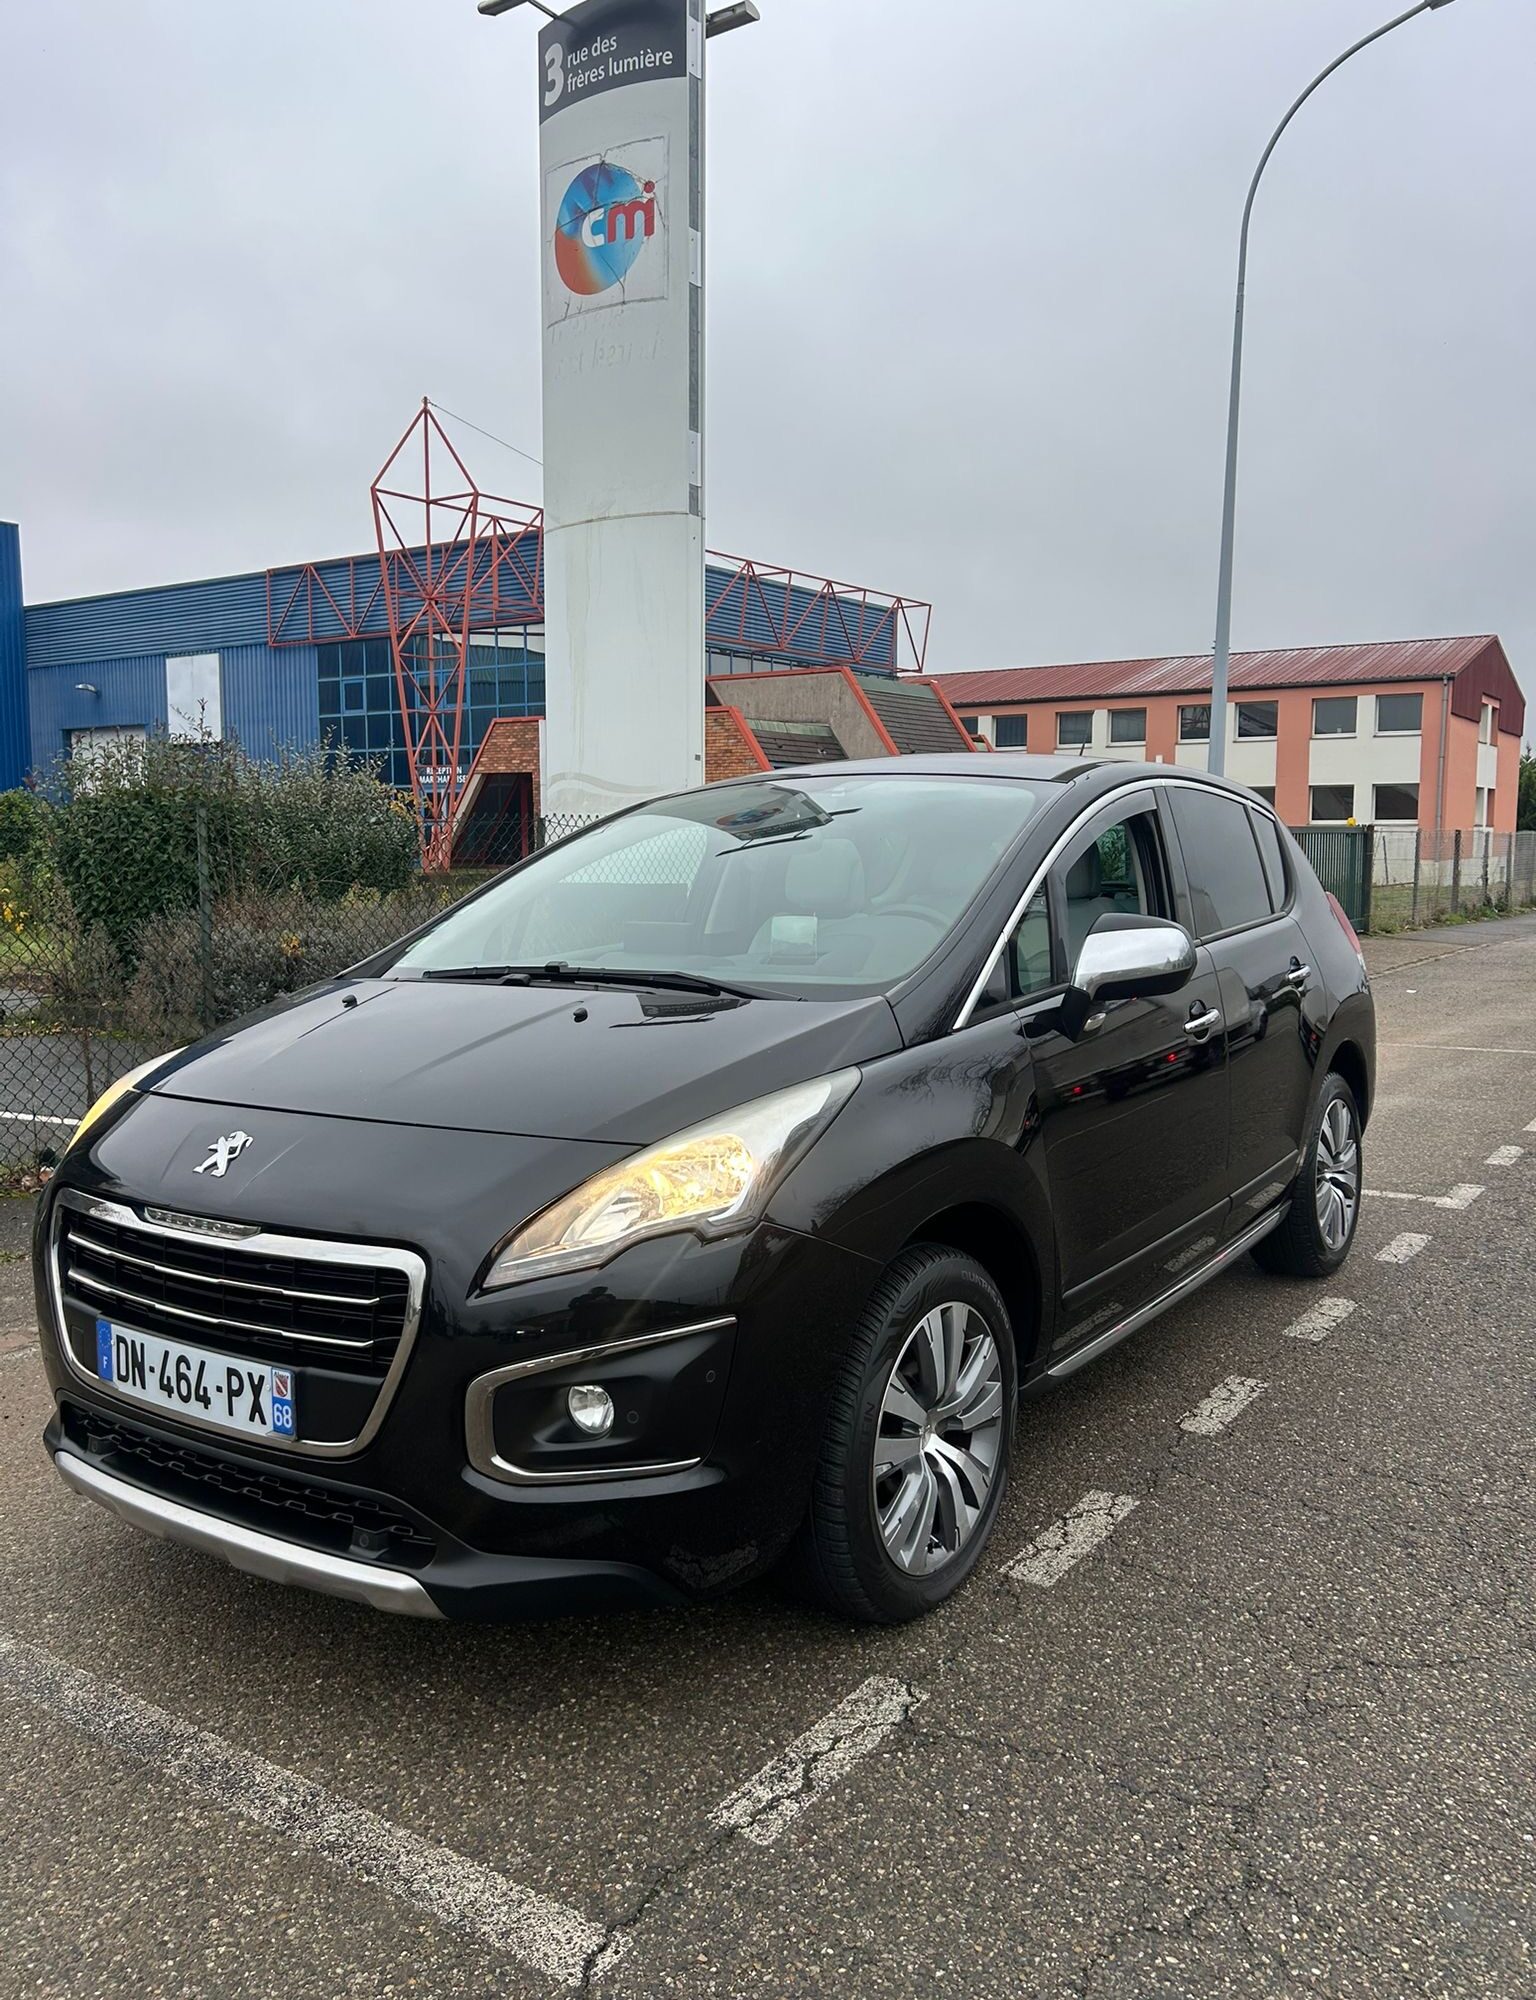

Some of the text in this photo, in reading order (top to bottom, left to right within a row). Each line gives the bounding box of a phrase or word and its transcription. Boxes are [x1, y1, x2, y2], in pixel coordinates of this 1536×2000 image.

[544, 36, 617, 107] 3 rue des
[567, 48, 673, 93] frères lumière
[581, 180, 655, 263] cmi
[103, 1356, 109, 1368] F
[116, 1334, 268, 1426] DN-464-PX
[274, 1402, 292, 1428] 68
